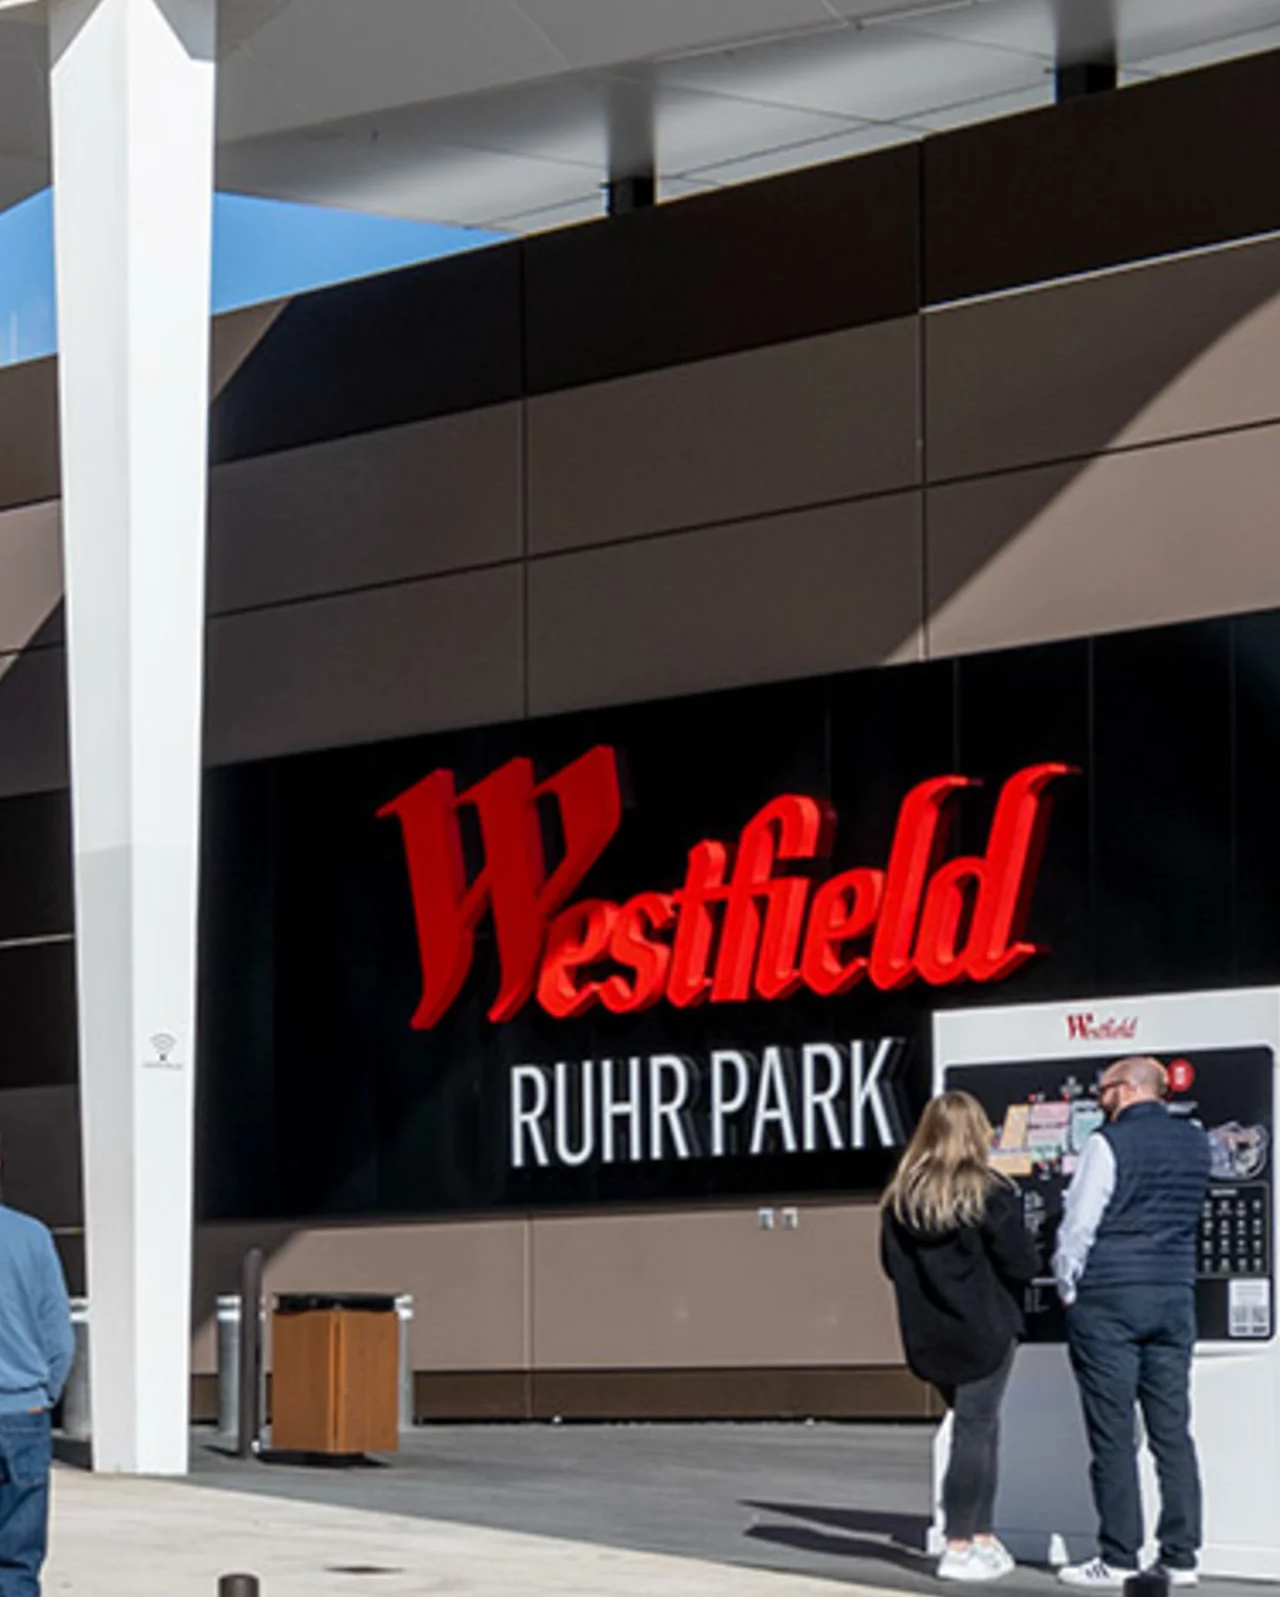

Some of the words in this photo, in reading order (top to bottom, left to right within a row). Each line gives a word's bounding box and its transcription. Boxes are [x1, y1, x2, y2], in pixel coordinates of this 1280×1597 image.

[376, 745, 1081, 1029] Westfield
[511, 1054, 690, 1167] RUHR
[711, 1037, 895, 1156] PARK
